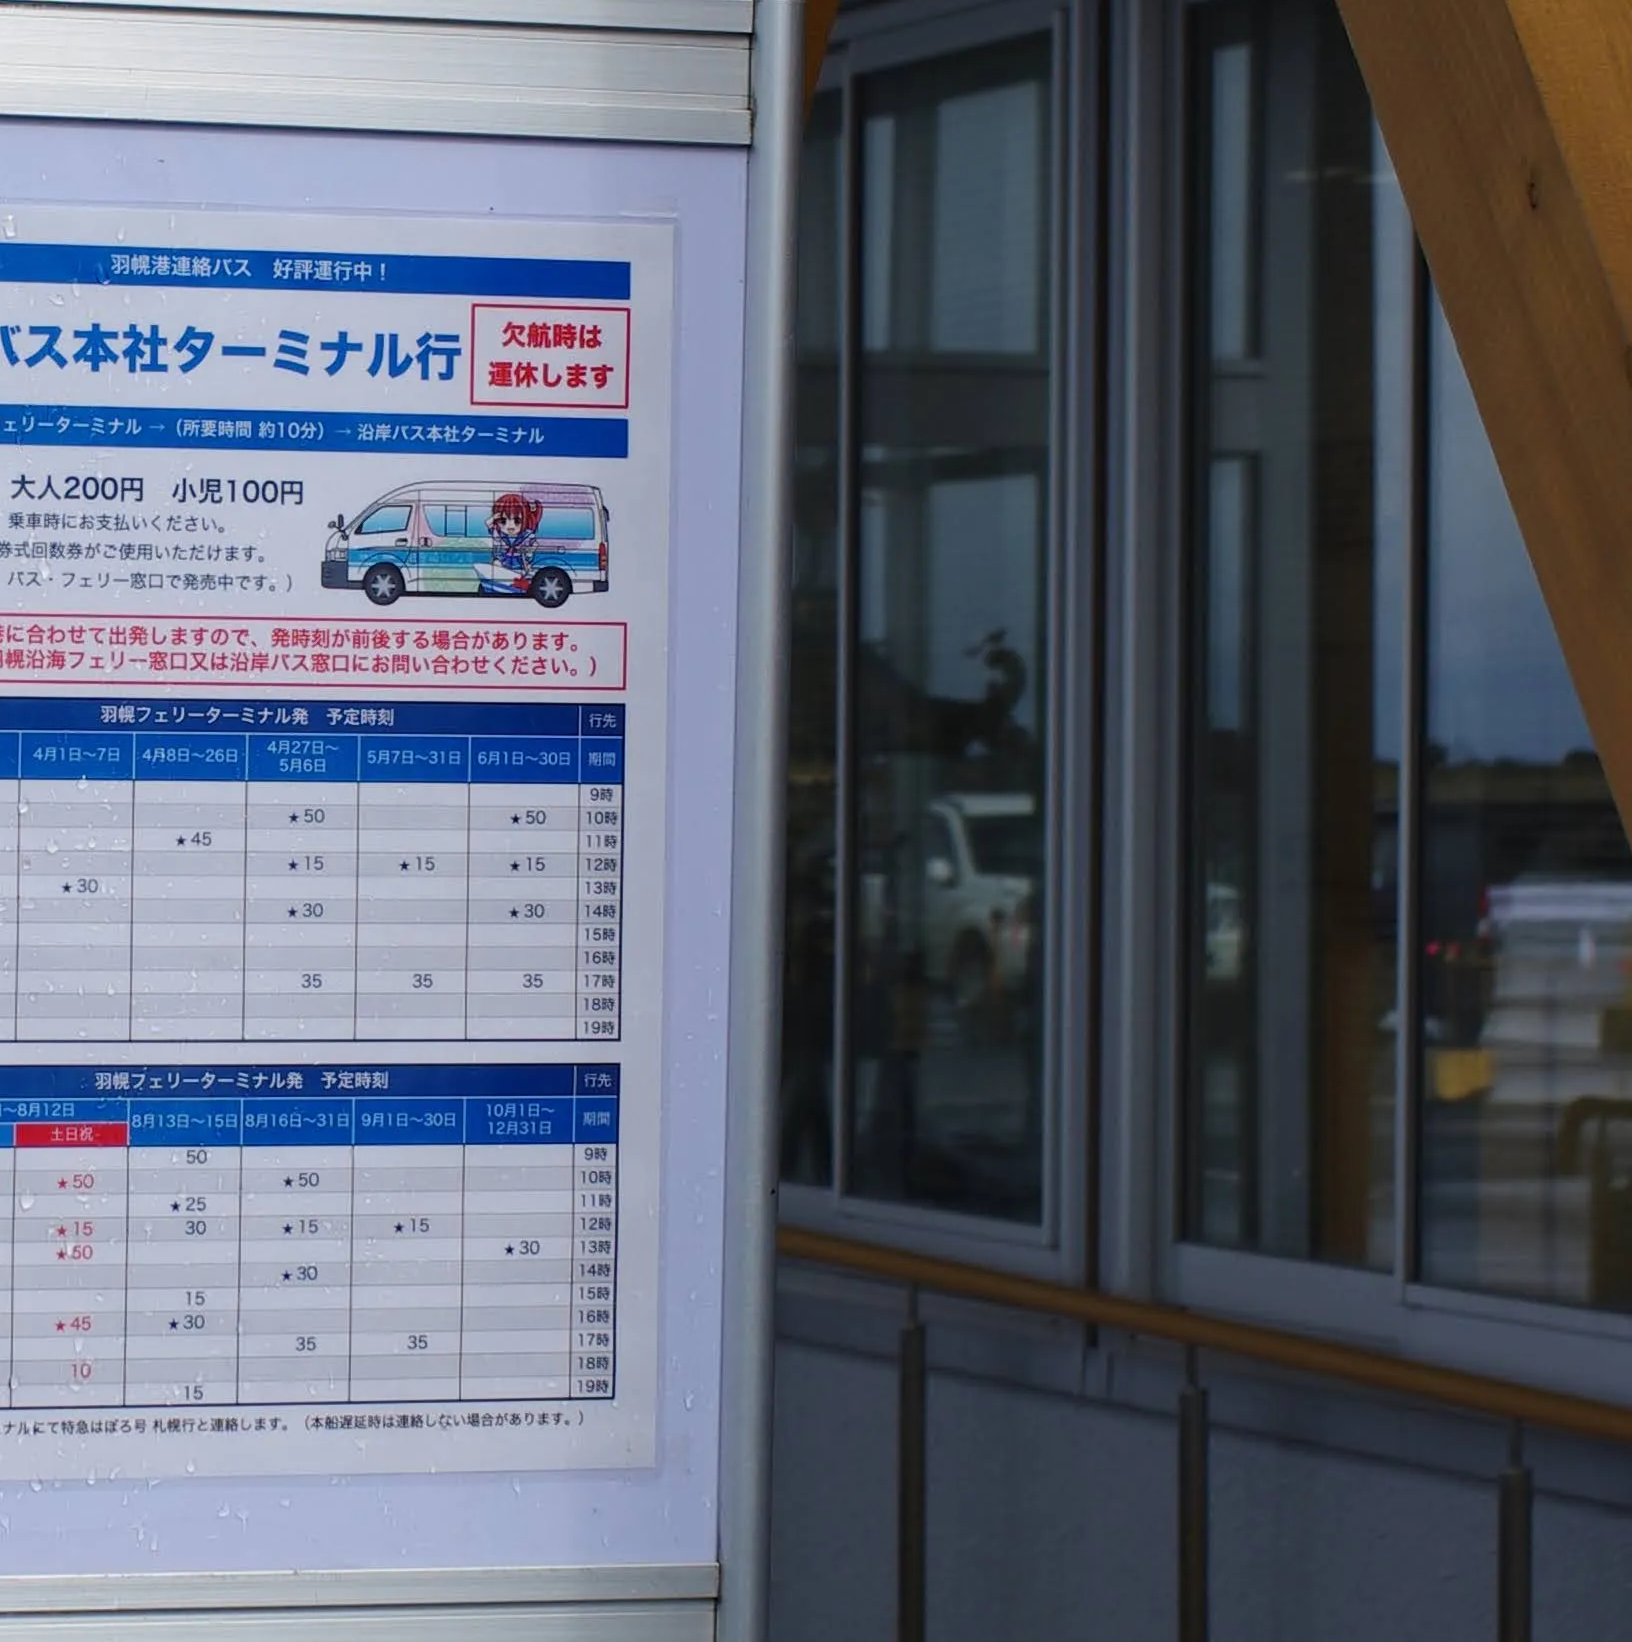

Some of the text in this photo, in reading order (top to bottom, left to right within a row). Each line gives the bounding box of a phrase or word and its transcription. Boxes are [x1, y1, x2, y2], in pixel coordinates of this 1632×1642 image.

[110, 255, 387, 282] 羽幌港連絡バス 好評運行中！
[501, 321, 602, 349] 欠航時は
[488, 361, 614, 388] 運休します
[357, 423, 544, 444] 沿岸バス本社ターミナル
[11, 476, 145, 502] 大人200円
[172, 478, 304, 505] 小児100円
[100, 705, 309, 725] 羽幌フェリーターミナル発
[327, 708, 394, 726] 予定時刻
[589, 713, 617, 729] 行先
[280, 758, 327, 773] 5月6日
[588, 752, 616, 768] 期間
[590, 788, 613, 802] 9時
[304, 809, 325, 824] 50
[526, 810, 547, 825] 50
[586, 811, 617, 826] 10時
[190, 832, 212, 846] 45
[586, 835, 617, 849] 11時
[305, 856, 324, 871] 15
[416, 857, 435, 871] 15
[526, 857, 546, 871] 15
[586, 858, 617, 873] 12時
[77, 879, 99, 893] 30
[586, 881, 617, 895] 13時
[302, 903, 324, 918] 30
[524, 904, 545, 918] 30
[585, 905, 616, 919] 14時
[584, 928, 616, 942] 15時
[584, 951, 616, 965] 16時
[302, 974, 322, 988] 35
[412, 974, 433, 988] 35
[522, 974, 543, 988] 35
[584, 975, 615, 989] 17時
[583, 998, 614, 1012] 18時
[583, 1021, 614, 1036] 19時
[95, 1072, 303, 1090] 羽幌フェリーターミナル発
[321, 1072, 389, 1089] 予定時刻
[584, 1073, 612, 1088] 行先
[583, 1111, 610, 1126] 期間
[51, 1127, 94, 1143] 土日祝
[488, 1121, 552, 1136] 12月31日
[187, 1149, 207, 1165] 50
[584, 1147, 607, 1161] 9時
[72, 1174, 94, 1189] 50
[298, 1173, 319, 1187] 50
[581, 1171, 612, 1185] 10時
[186, 1197, 206, 1212] 25
[581, 1194, 612, 1208] 11時
[74, 1222, 92, 1237] 15
[185, 1221, 206, 1236] 30
[299, 1220, 319, 1235] 15
[410, 1219, 429, 1233] 15
[580, 1217, 611, 1231] 12時
[71, 1245, 92, 1260] 50
[519, 1241, 540, 1256] 30
[580, 1240, 611, 1255] 13時
[297, 1266, 318, 1281] 30
[579, 1264, 610, 1278] 14時
[186, 1291, 205, 1306] 15
[579, 1287, 610, 1301] 15時
[70, 1317, 91, 1331] 45
[183, 1315, 205, 1330] 30
[578, 1310, 609, 1325] 16時
[296, 1337, 316, 1352] 35
[407, 1336, 428, 1350] 35
[578, 1333, 609, 1348] 17時
[72, 1364, 91, 1379] 10
[577, 1356, 609, 1371] 18時
[184, 1386, 204, 1401] 15
[577, 1379, 609, 1394] 19時
